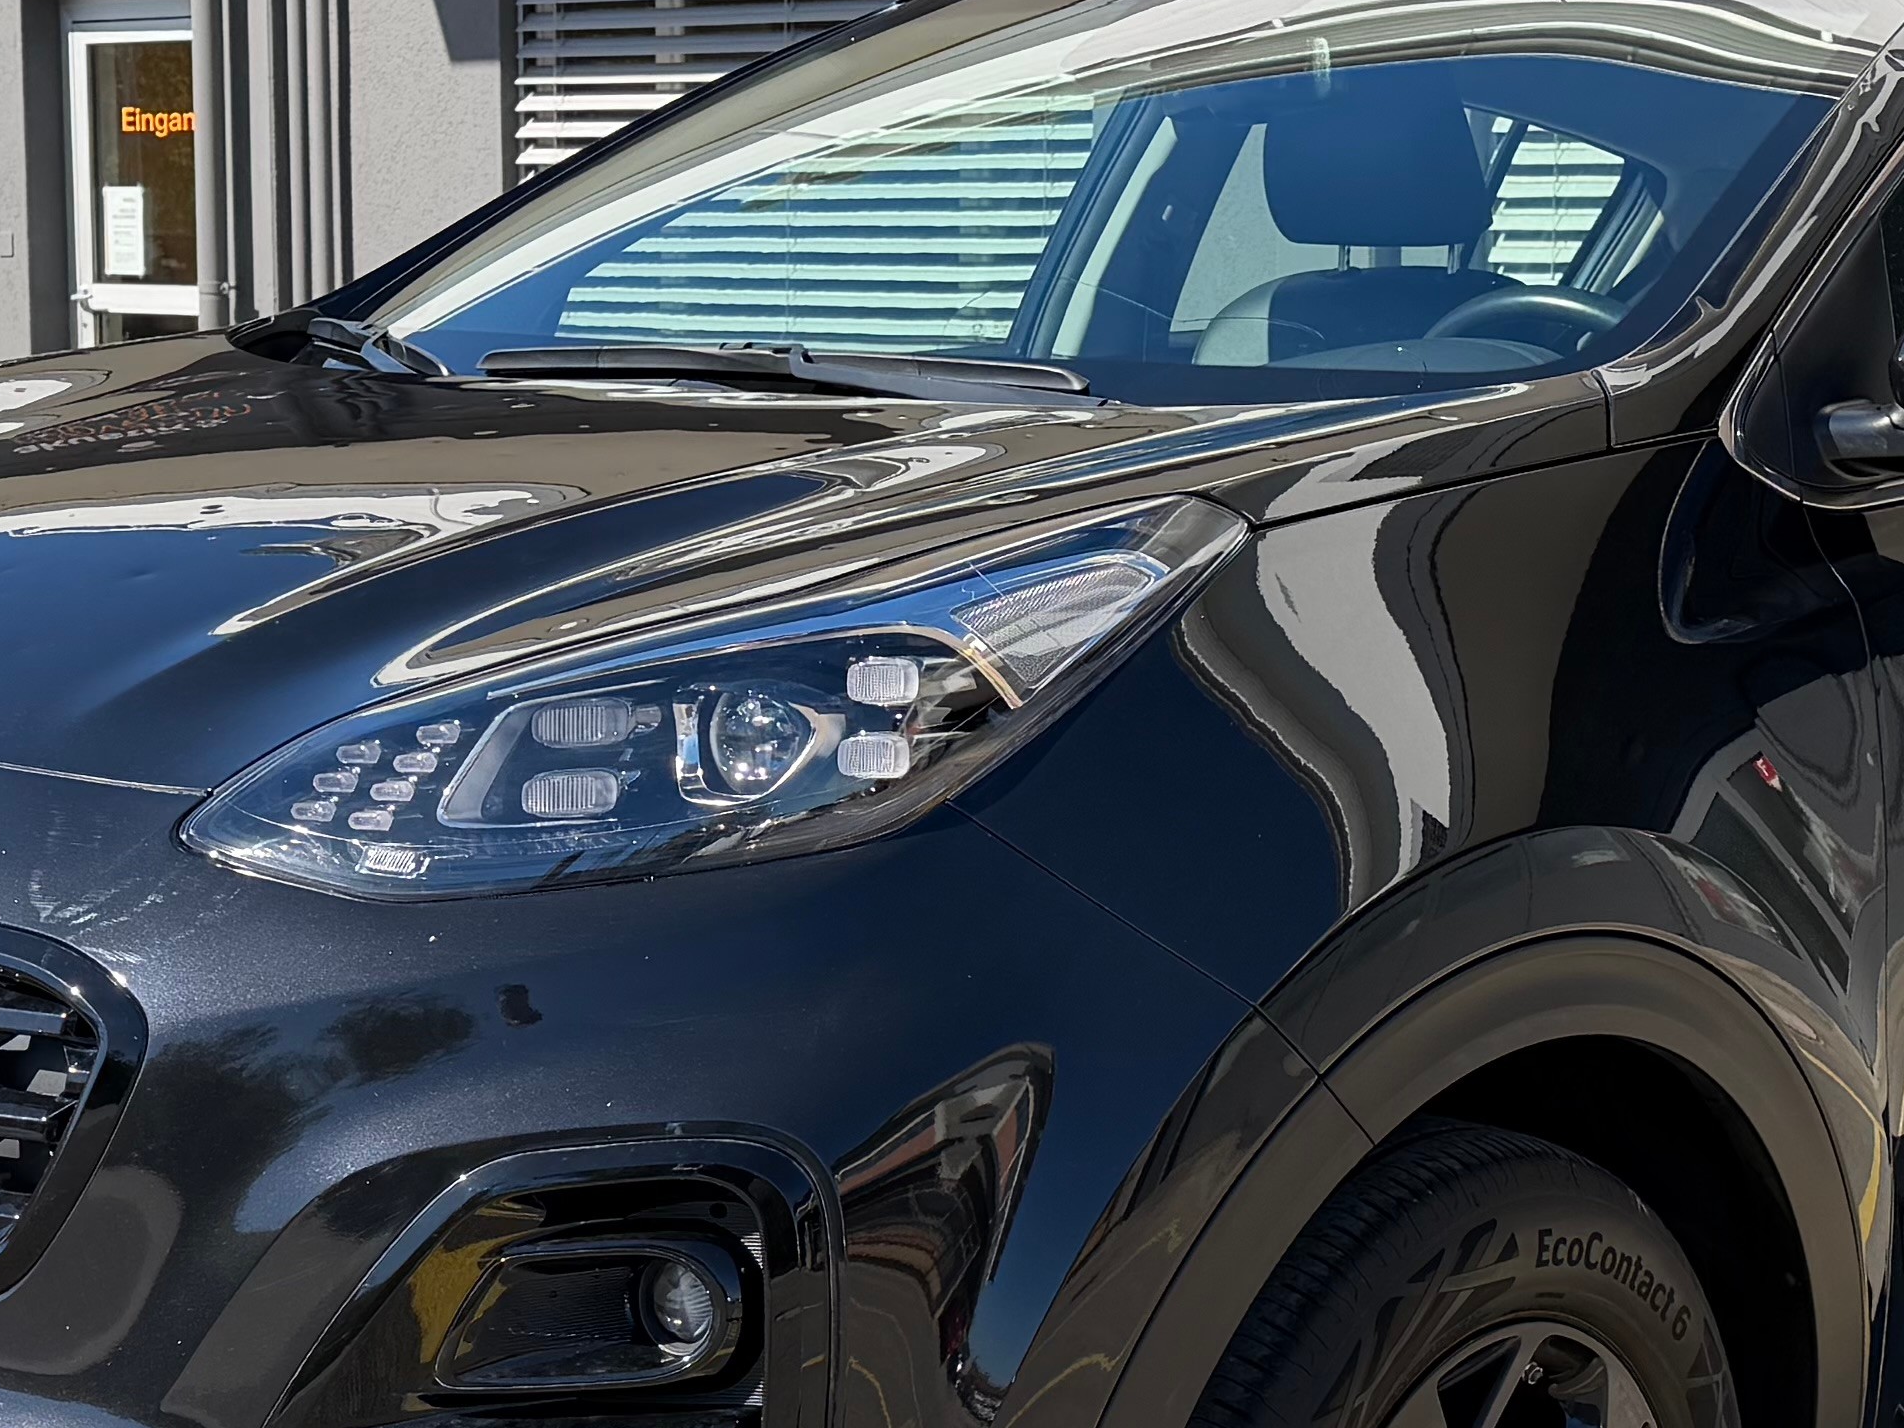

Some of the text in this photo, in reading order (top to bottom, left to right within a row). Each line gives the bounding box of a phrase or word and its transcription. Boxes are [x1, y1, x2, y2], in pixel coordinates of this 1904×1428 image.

[121, 106, 196, 138] Eingan
[1535, 1227, 1692, 1342] EcoContact 6
